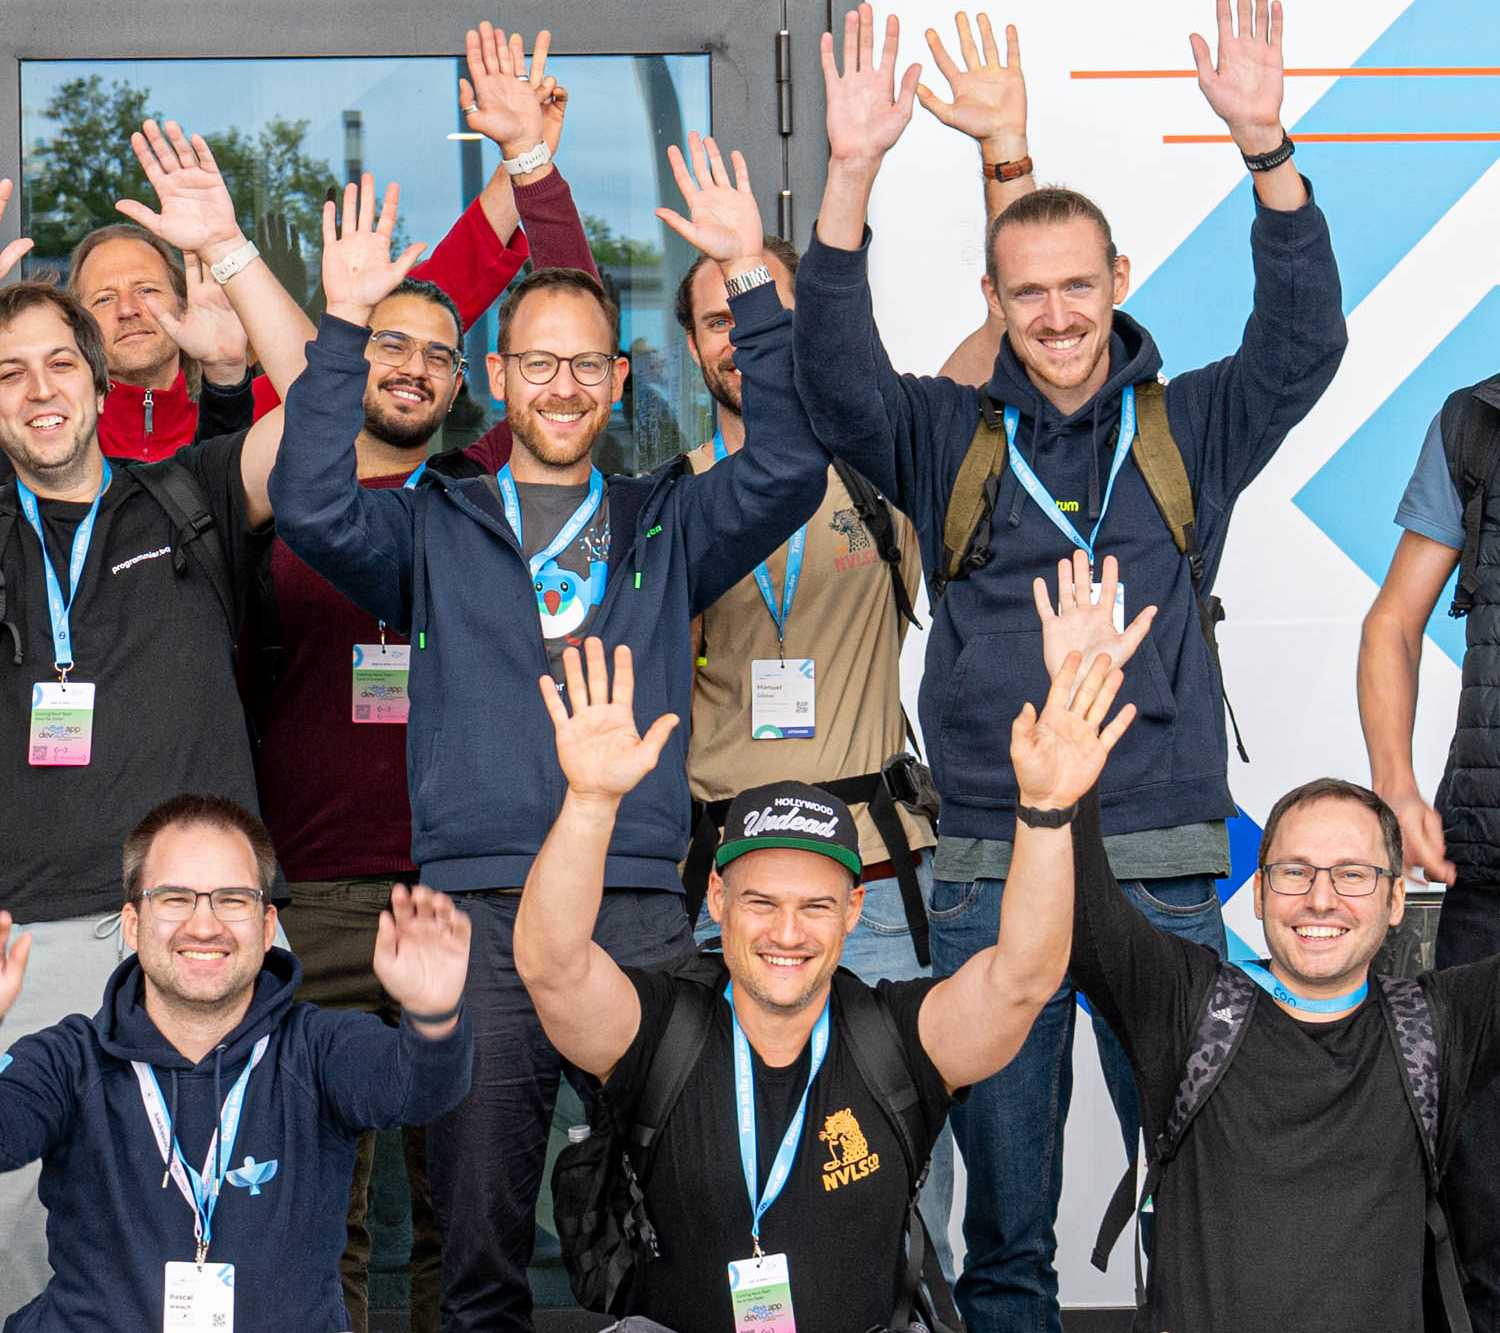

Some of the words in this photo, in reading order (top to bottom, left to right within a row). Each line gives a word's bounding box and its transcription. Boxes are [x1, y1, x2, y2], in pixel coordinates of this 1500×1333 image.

[774, 797, 834, 816] HOLLYWOOD
[743, 806, 839, 838] Undead
[741, 1107, 751, 1132] Time
